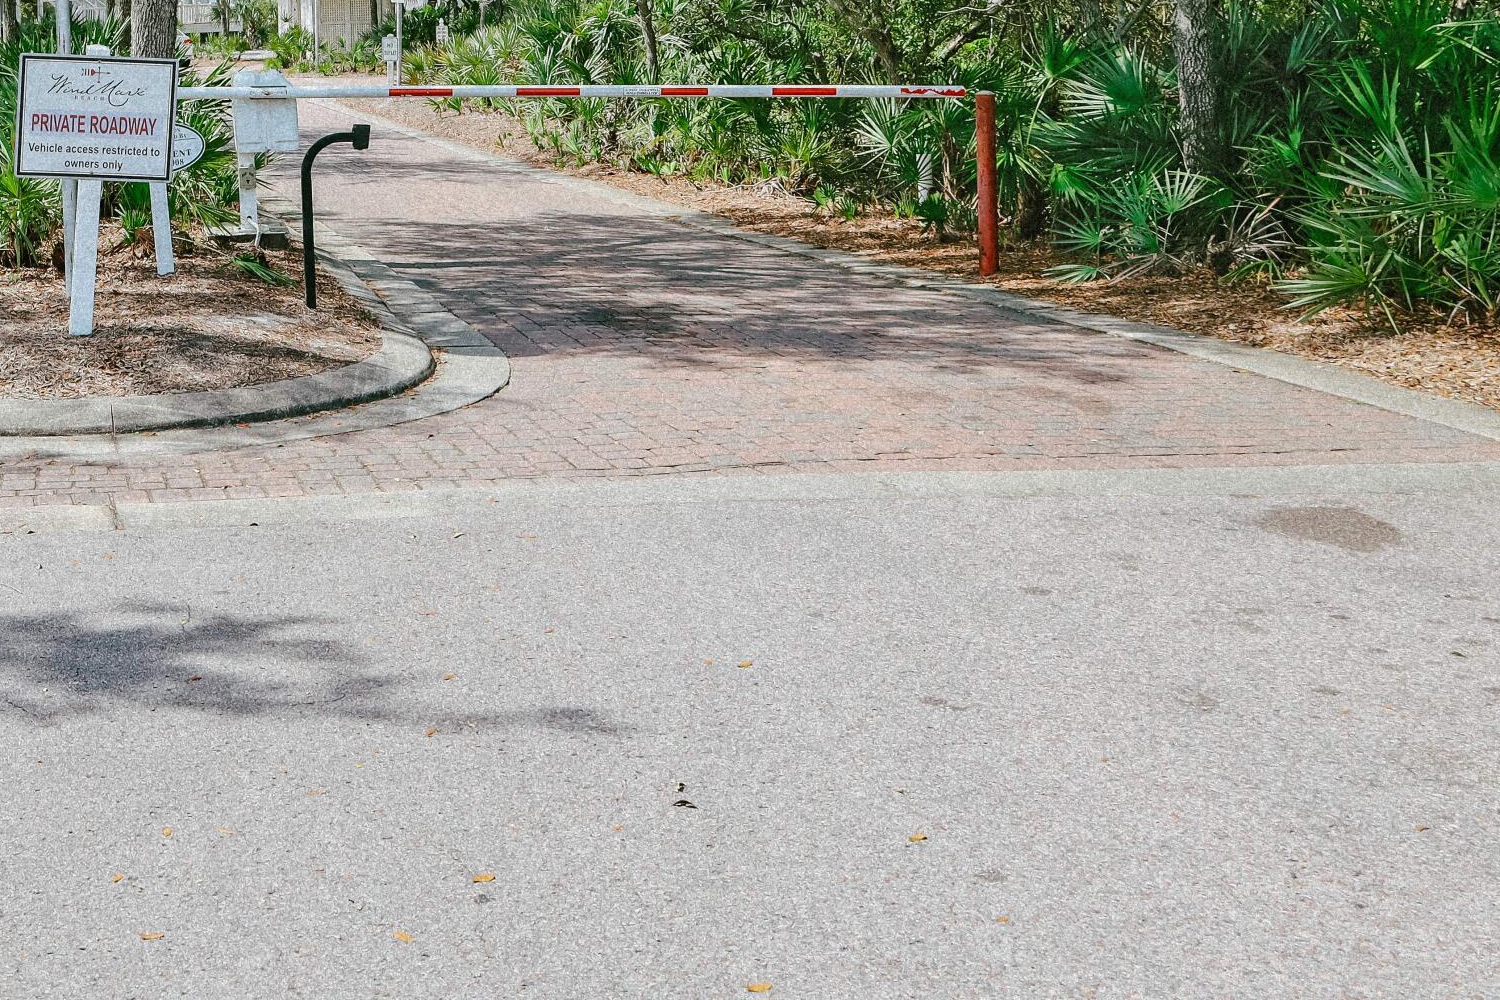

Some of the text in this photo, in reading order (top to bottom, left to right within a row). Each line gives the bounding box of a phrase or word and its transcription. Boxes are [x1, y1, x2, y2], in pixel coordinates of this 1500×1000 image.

[31, 113, 157, 136] PRIVATE ROADWAY
[28, 142, 160, 157] Vehicle access restricted to
[64, 160, 123, 172] owners only
